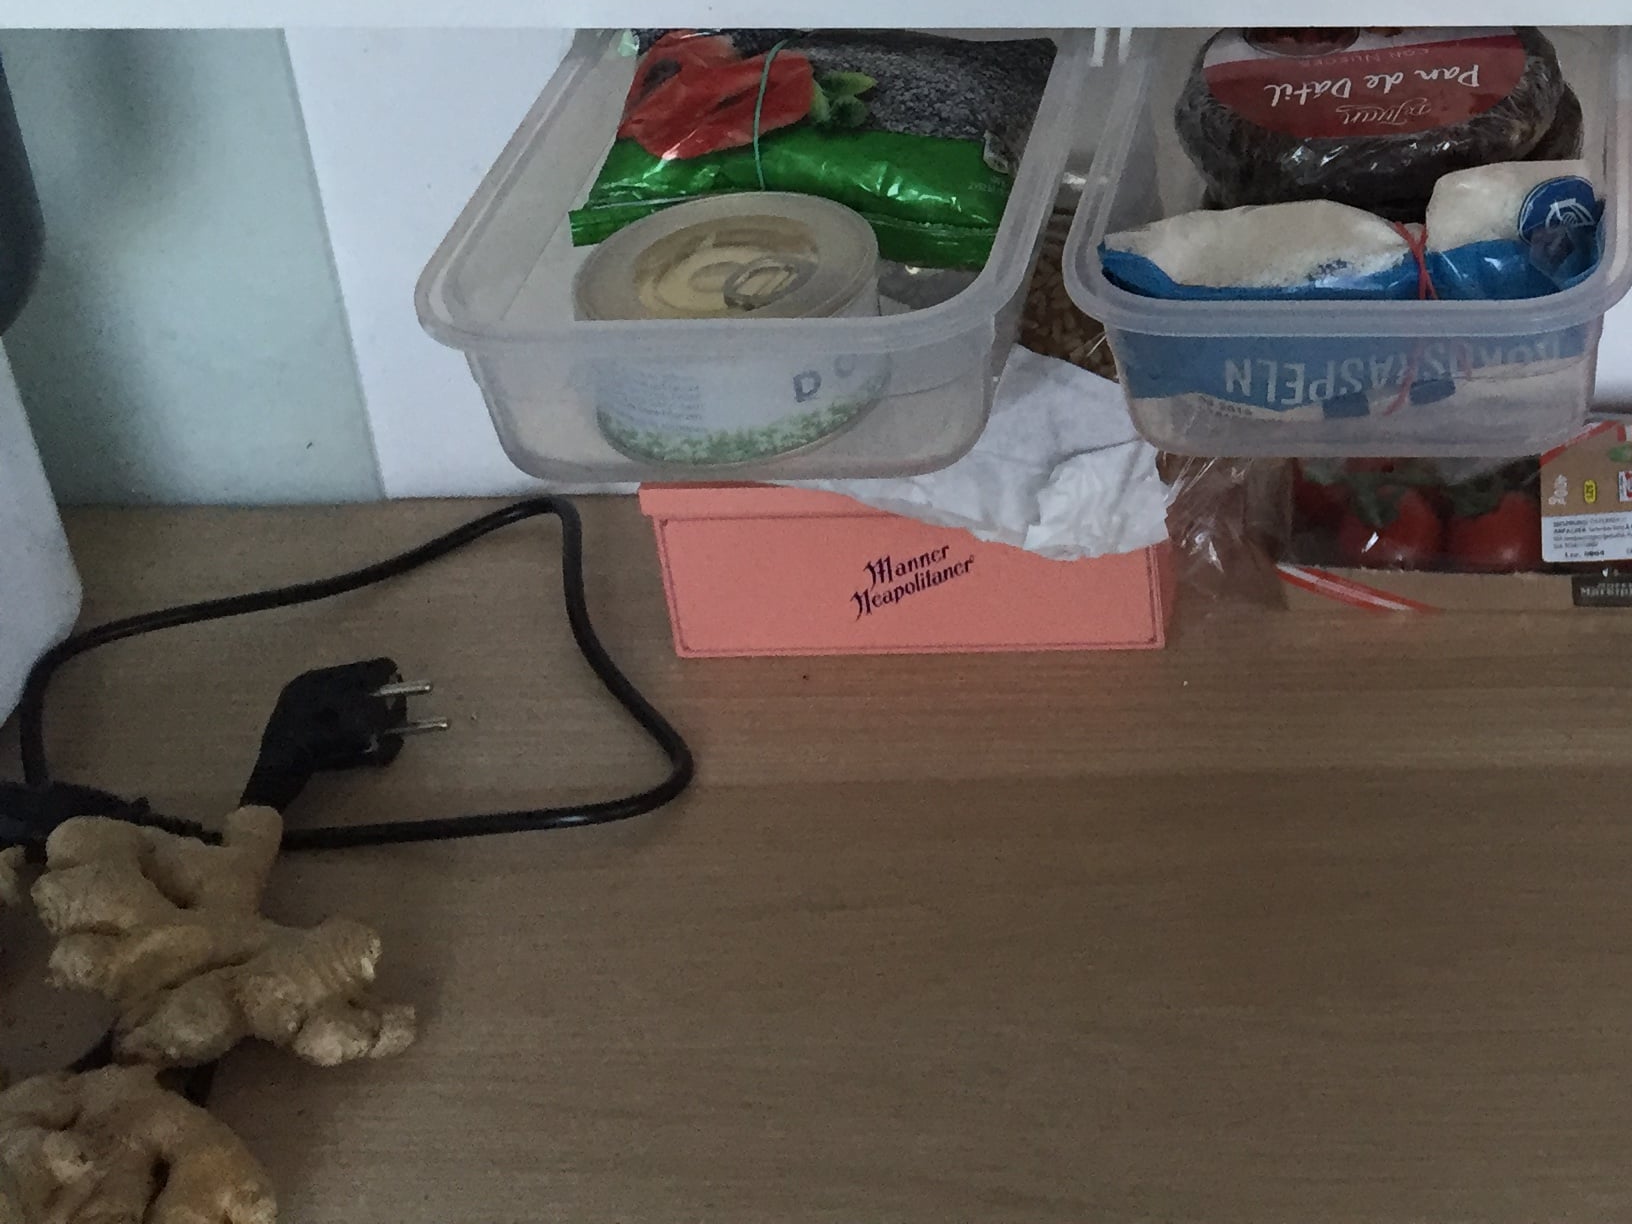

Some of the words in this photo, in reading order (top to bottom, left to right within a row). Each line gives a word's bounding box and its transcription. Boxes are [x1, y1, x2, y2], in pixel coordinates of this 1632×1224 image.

[1367, 72, 1404, 95] de
[1414, 64, 1480, 88] Pan
[863, 545, 950, 592] Manner
